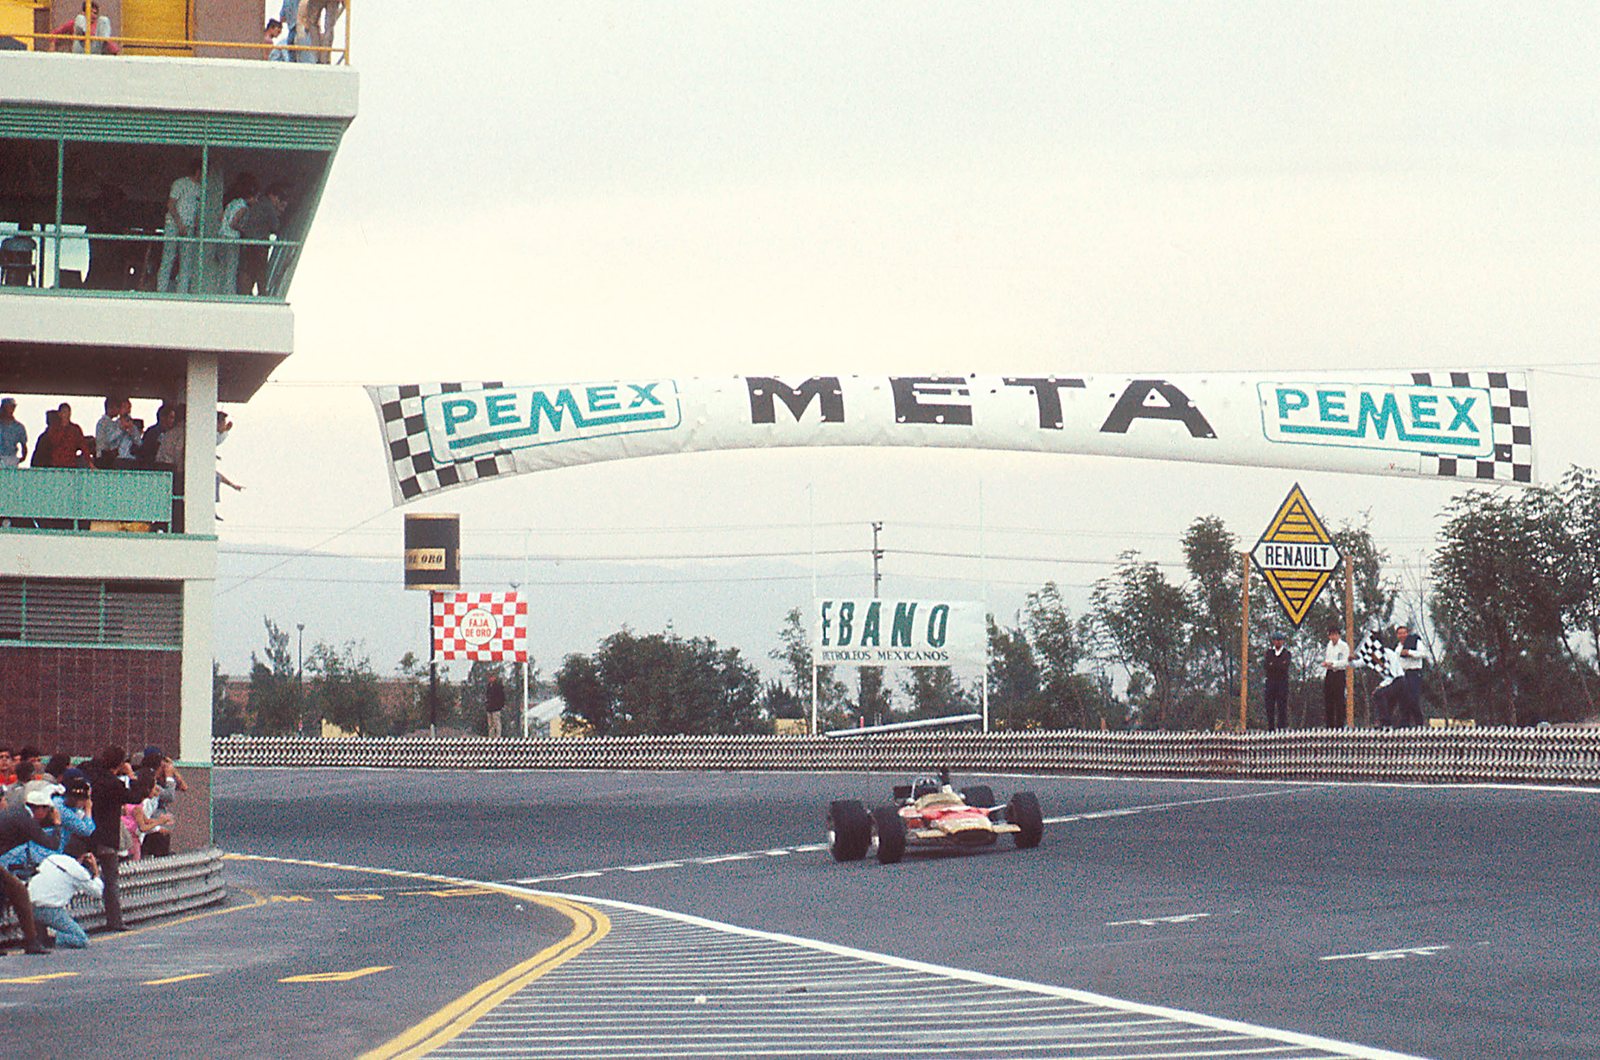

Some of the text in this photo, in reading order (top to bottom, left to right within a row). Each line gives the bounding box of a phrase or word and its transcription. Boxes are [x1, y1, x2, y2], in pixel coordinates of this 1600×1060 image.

[442, 383, 666, 449] PEMEX
[746, 376, 1218, 438] META
[1275, 388, 1481, 446] PEMEX
[421, 554, 443, 563] ORO
[1265, 545, 1329, 567] RENAULT
[465, 628, 491, 637] DE ORO
[469, 618, 489, 627] FAJA
[821, 601, 950, 648] EBANO
[878, 651, 949, 661] MEXICANOS
